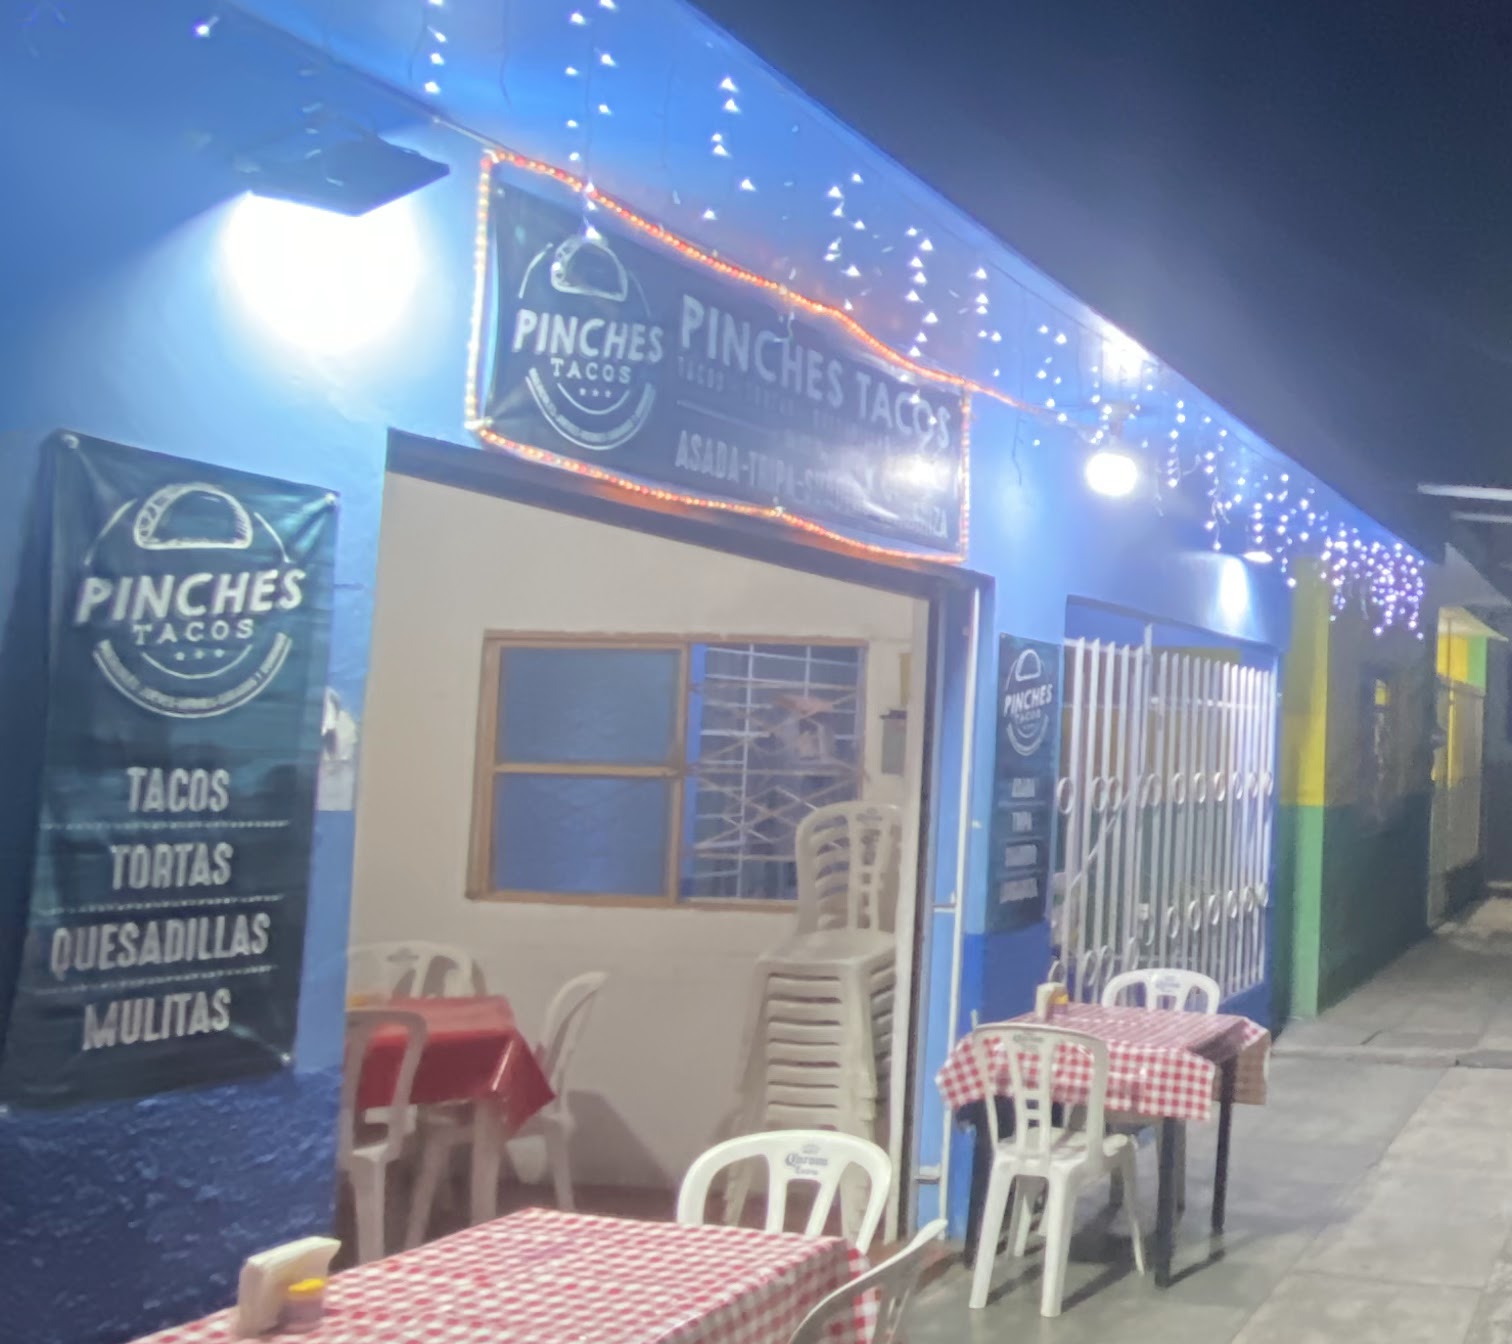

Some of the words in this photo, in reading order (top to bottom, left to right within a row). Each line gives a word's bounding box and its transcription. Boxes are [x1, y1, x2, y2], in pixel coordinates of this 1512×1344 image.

[513, 309, 664, 363] PINCHES
[551, 357, 631, 384] TACOS
[679, 294, 844, 407] PINCHES
[855, 371, 951, 449] TACOS
[76, 569, 306, 623] PINCHES
[132, 618, 254, 645] TACOS
[1004, 684, 1053, 717] PINCHES
[128, 767, 230, 814] TACOS
[110, 843, 232, 890] TORTAS
[51, 913, 271, 979] QUESADILLAS
[83, 989, 231, 1051] MULITAS
